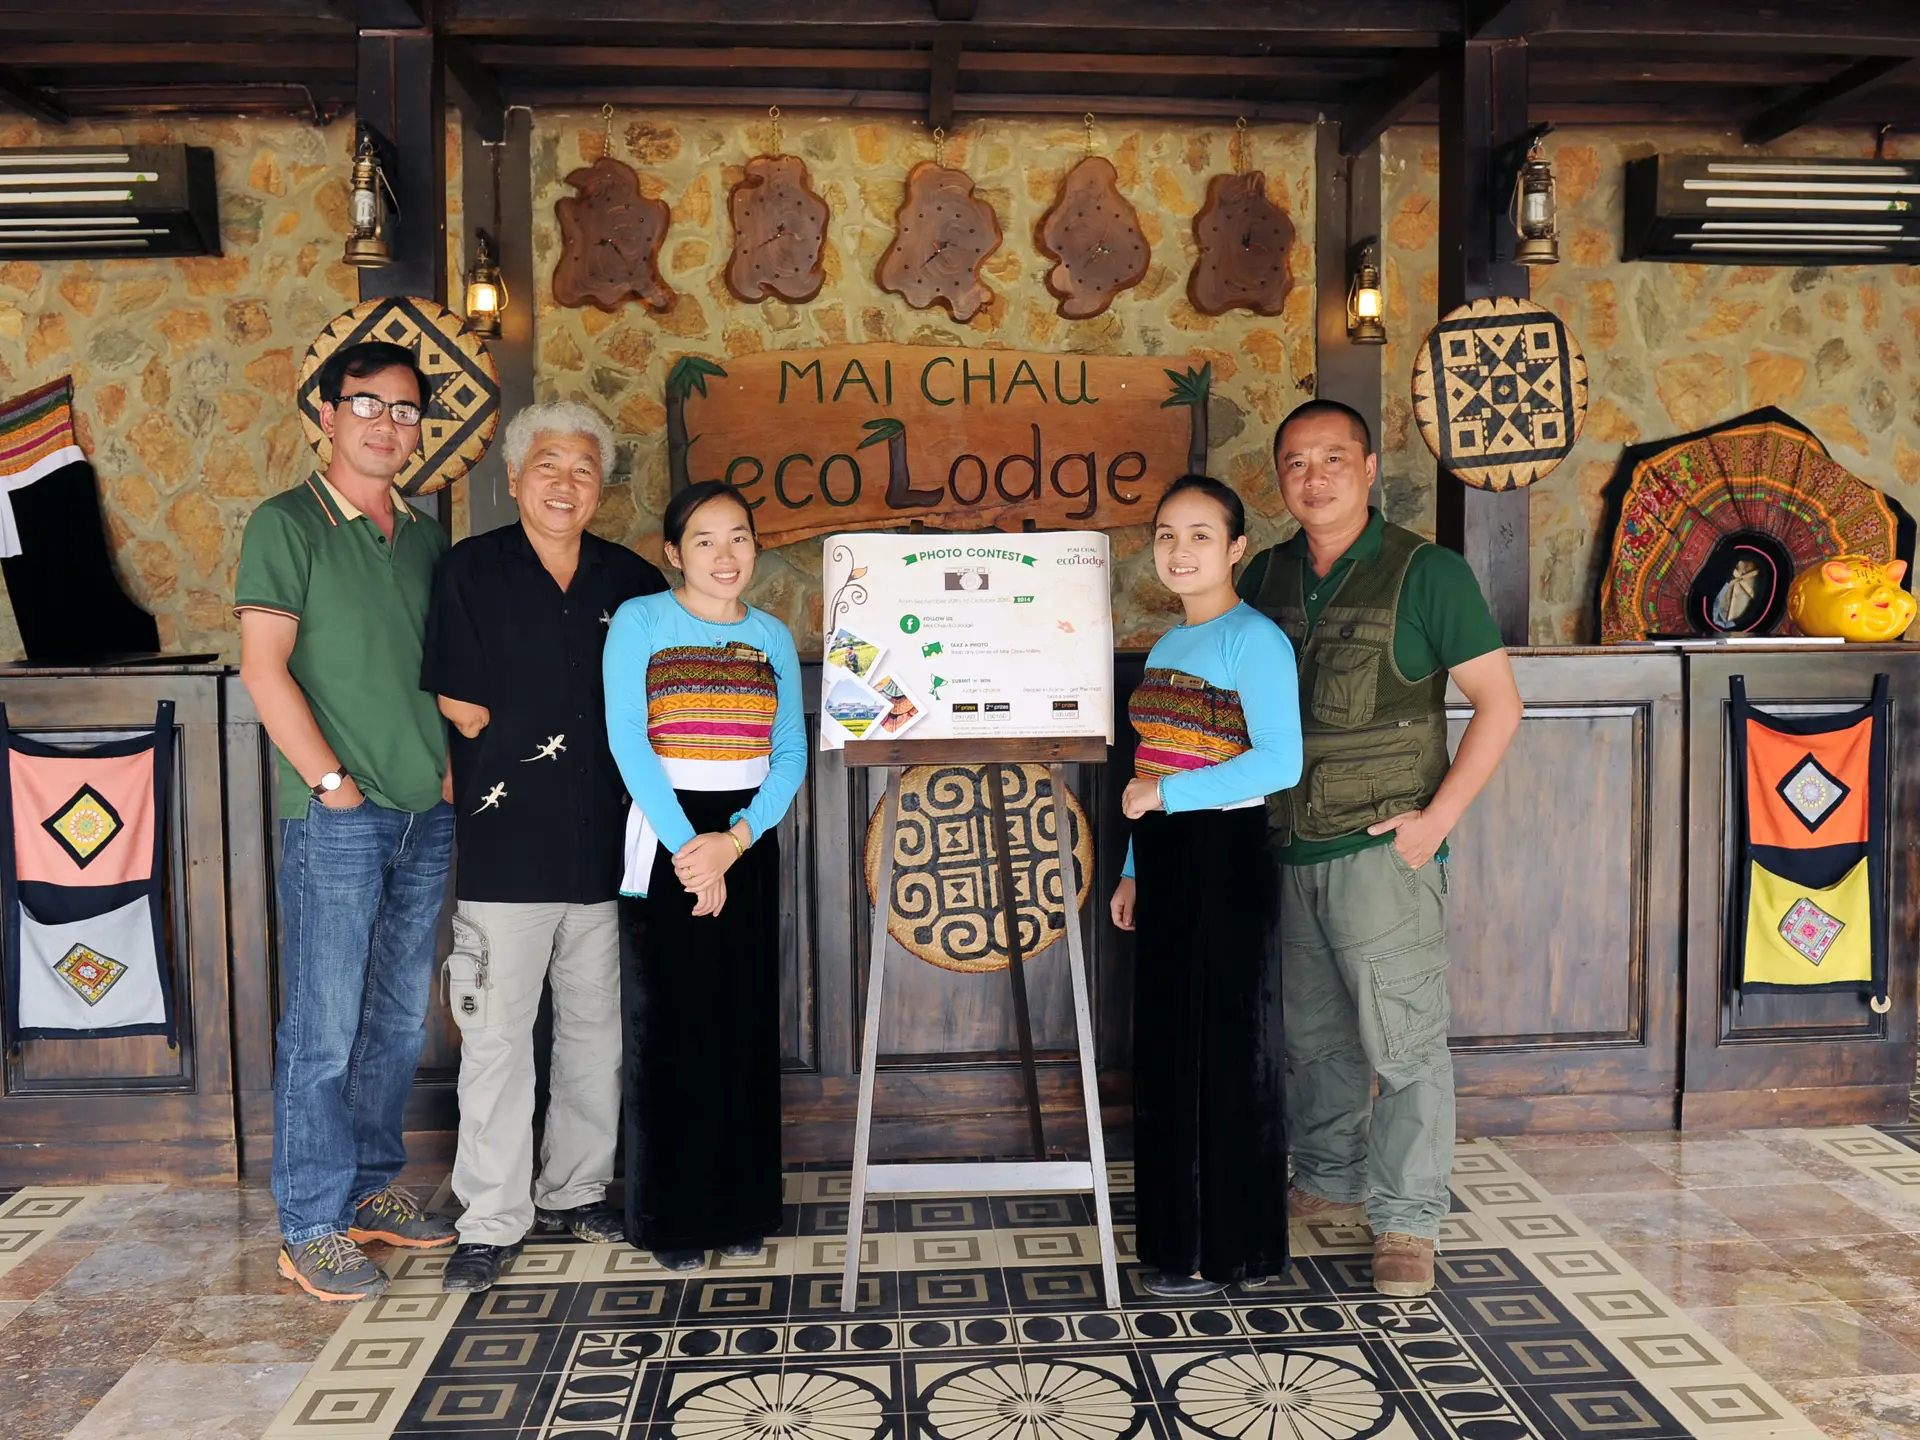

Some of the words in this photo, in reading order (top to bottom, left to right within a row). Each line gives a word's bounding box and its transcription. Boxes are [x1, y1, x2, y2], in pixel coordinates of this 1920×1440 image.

[779, 359, 894, 406] MAI
[920, 356, 1099, 406] CHAU
[919, 548, 962, 561] PHOTO
[966, 548, 1022, 562] CONTEST
